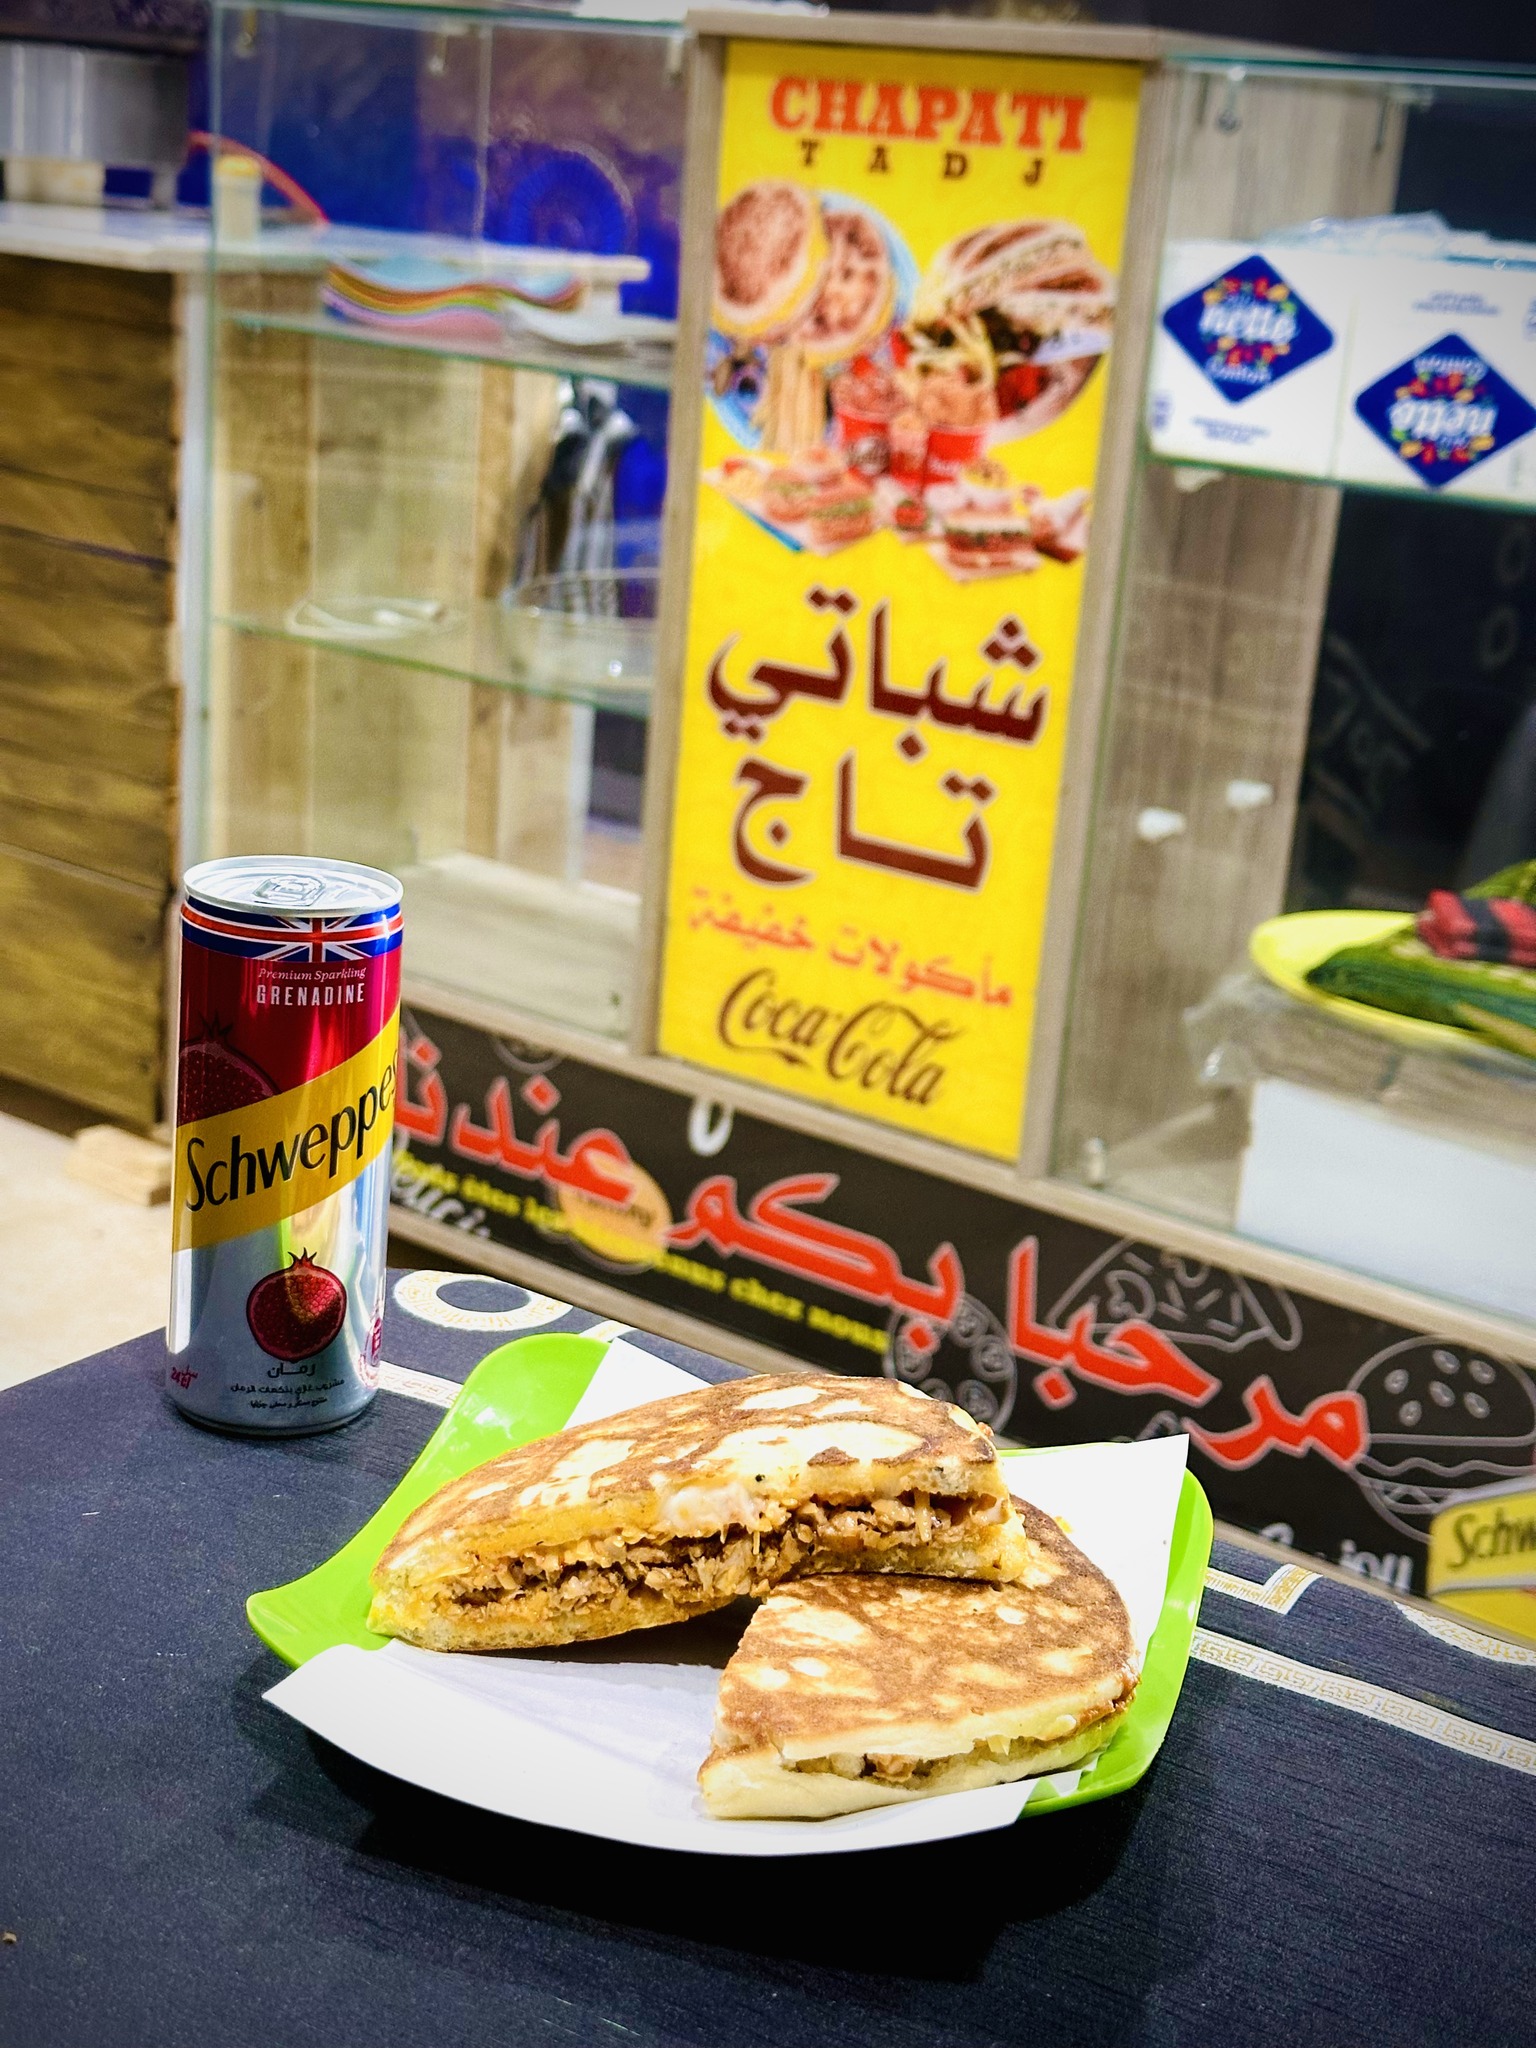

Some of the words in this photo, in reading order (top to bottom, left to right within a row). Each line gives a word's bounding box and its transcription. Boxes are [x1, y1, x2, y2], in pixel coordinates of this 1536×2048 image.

[769, 77, 1092, 154] CHAPATI
[707, 585, 1053, 760] شباتي
[731, 747, 995, 894] تاج
[688, 885, 814, 951] خفيفة
[256, 982, 366, 1006] GRENADINE
[258, 968, 312, 981] Premium
[314, 966, 367, 983] Sparkling
[717, 966, 964, 1105] Coca-Cola
[664, 1171, 967, 1354] بكم
[267, 1362, 316, 1379] رمان
[1006, 1235, 1370, 1470] مرحبا
